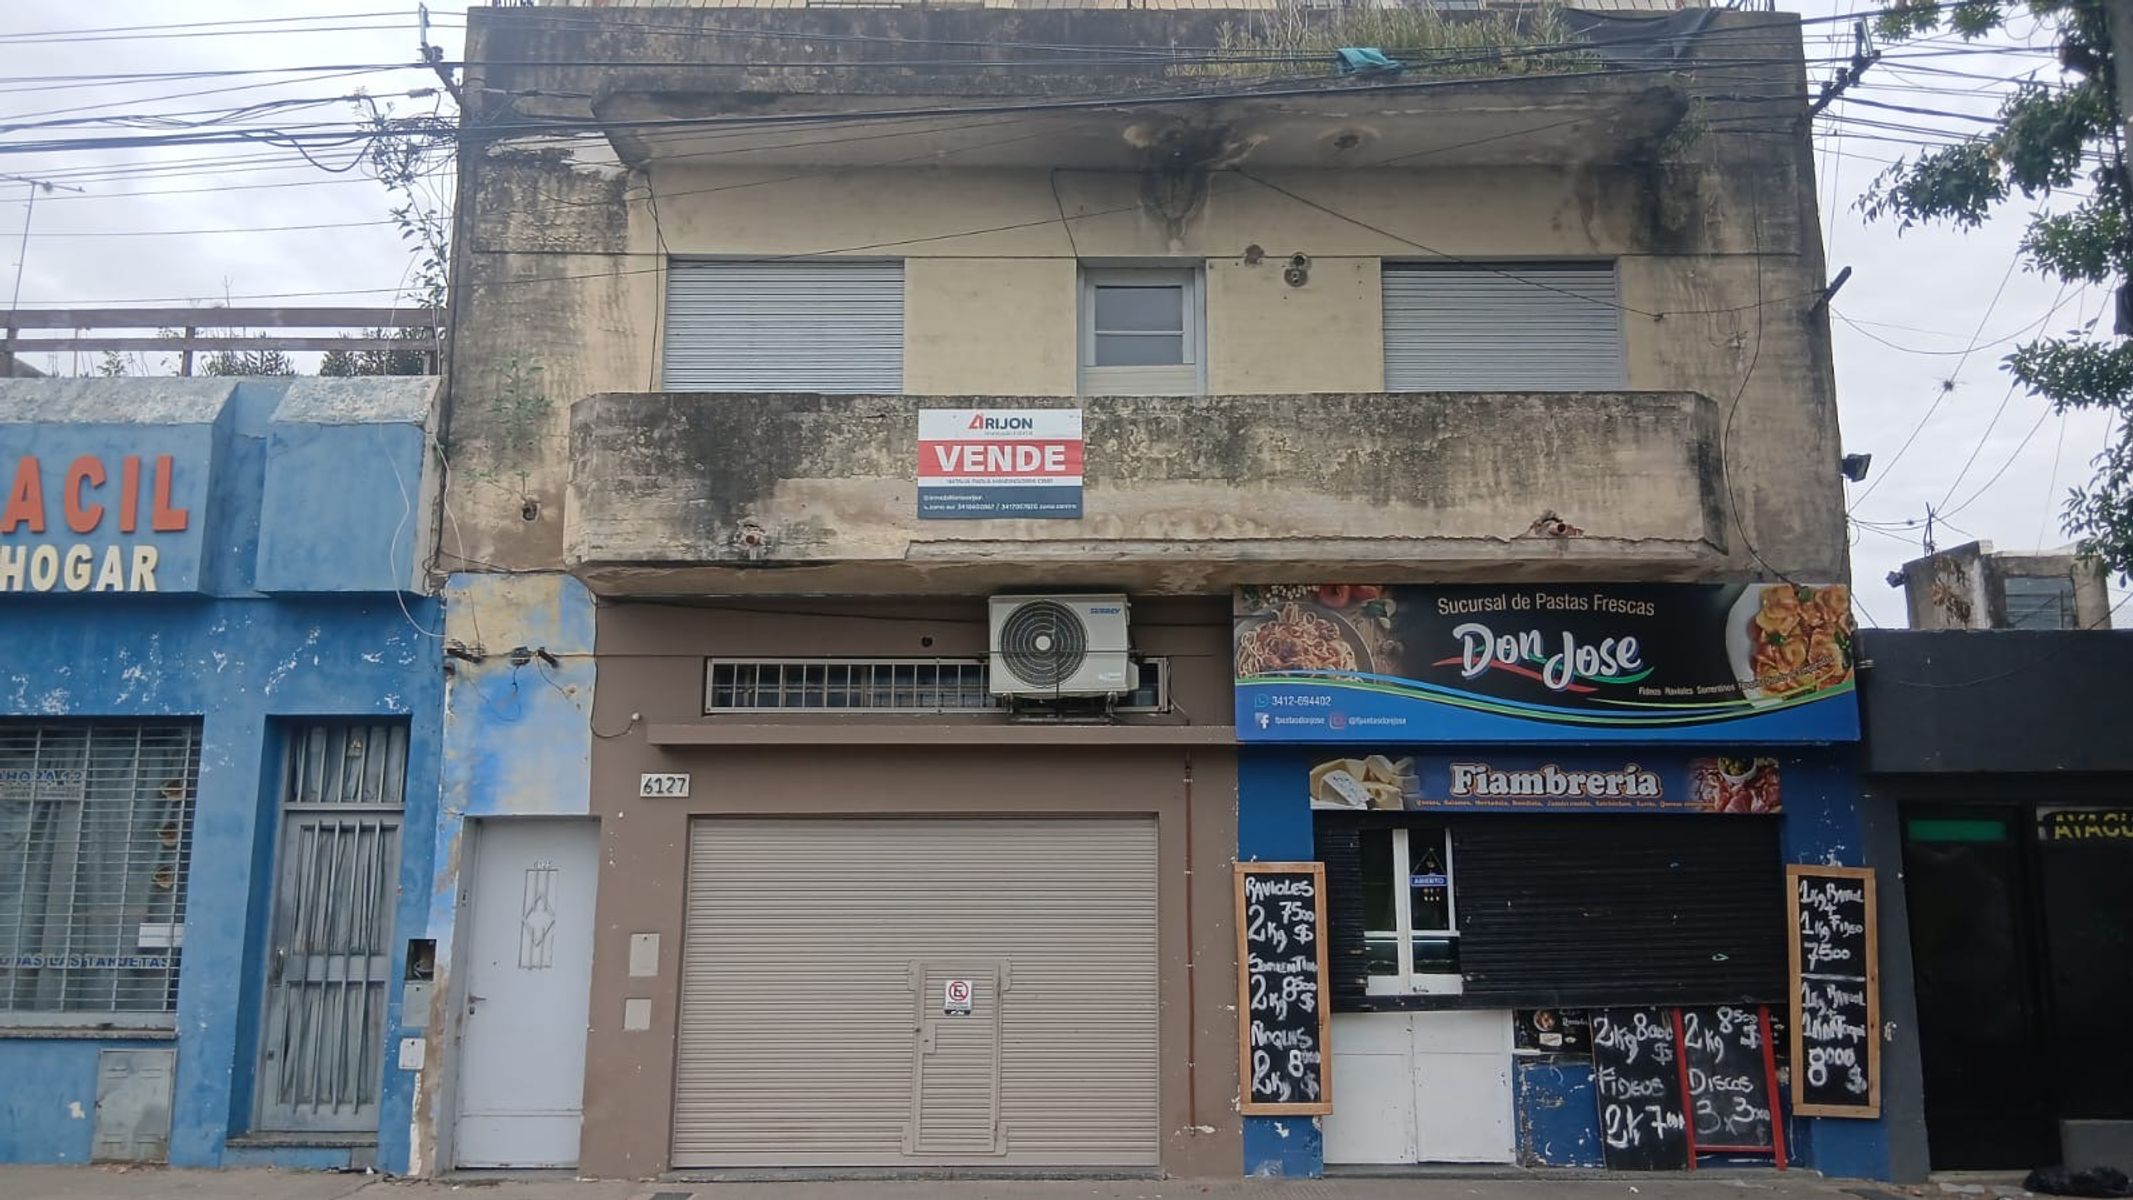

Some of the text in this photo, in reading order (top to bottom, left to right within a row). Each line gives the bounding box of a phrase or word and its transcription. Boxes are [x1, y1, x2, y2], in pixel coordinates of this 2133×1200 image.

[968, 413, 1033, 430] ARIJON
[934, 445, 1066, 472] VENDE
[1, 454, 188, 533] ACIL
[0, 544, 159, 592] HOGAR
[1438, 593, 1655, 616] Sucursal de Pastas Frescas
[1453, 622, 1641, 690] Don Jose
[1271, 696, 1331, 706] 3412-694402
[643, 776, 686, 794] 6127
[1452, 764, 1660, 796] Fiambrería
